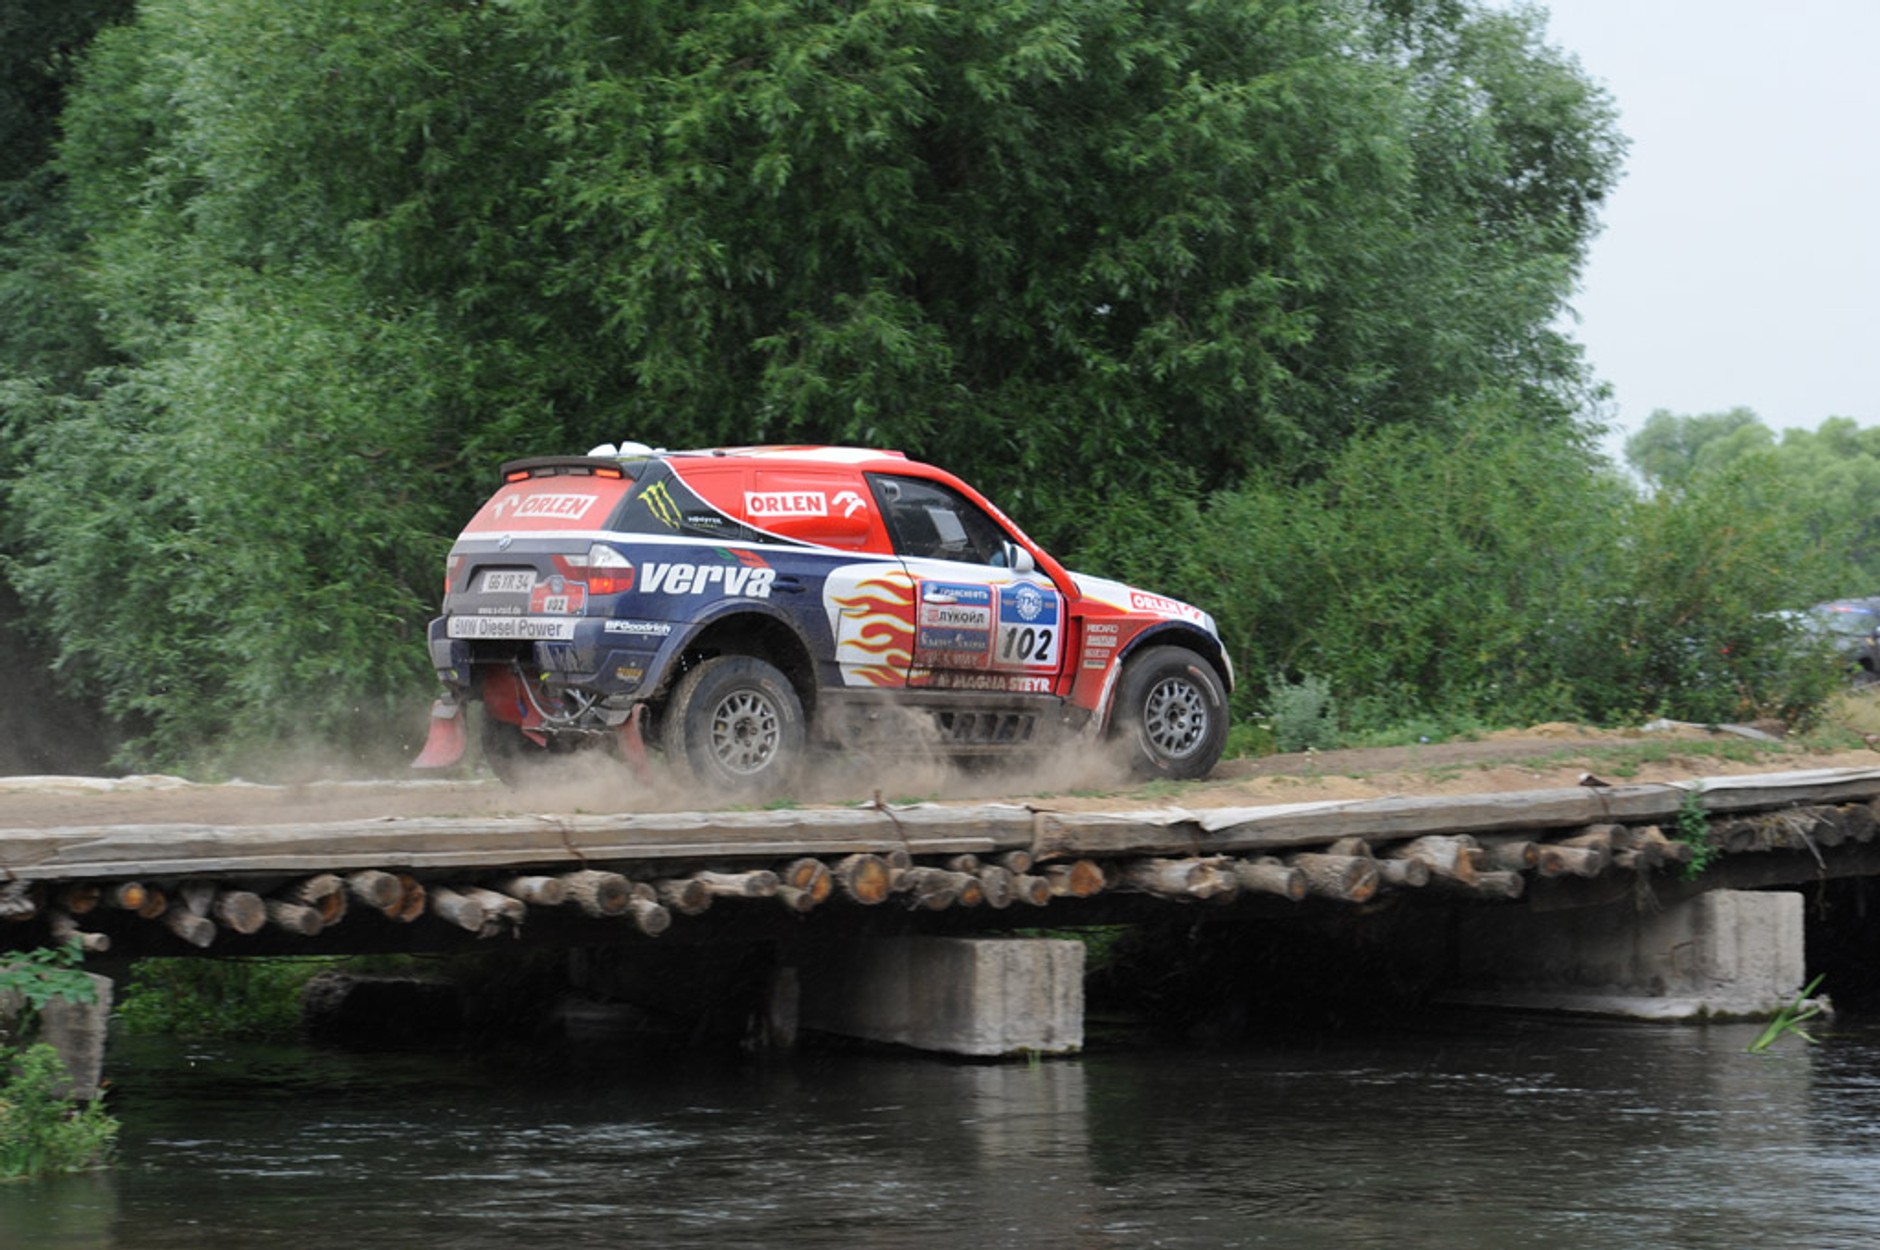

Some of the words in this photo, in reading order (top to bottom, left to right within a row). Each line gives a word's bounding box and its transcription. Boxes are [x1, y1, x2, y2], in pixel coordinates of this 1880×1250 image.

[521, 497, 588, 515] ORLEN
[751, 496, 821, 512] ORLEN
[639, 562, 776, 598] verva
[547, 599, 564, 611] 102
[940, 611, 984, 623] ЛУКОЙЛ
[455, 620, 477, 634] BMW
[480, 619, 516, 635] Diesel
[520, 620, 562, 637] Power
[605, 621, 671, 636] BFGoodrich
[1003, 627, 1052, 660] 102
[1009, 677, 1050, 692] STEYR
